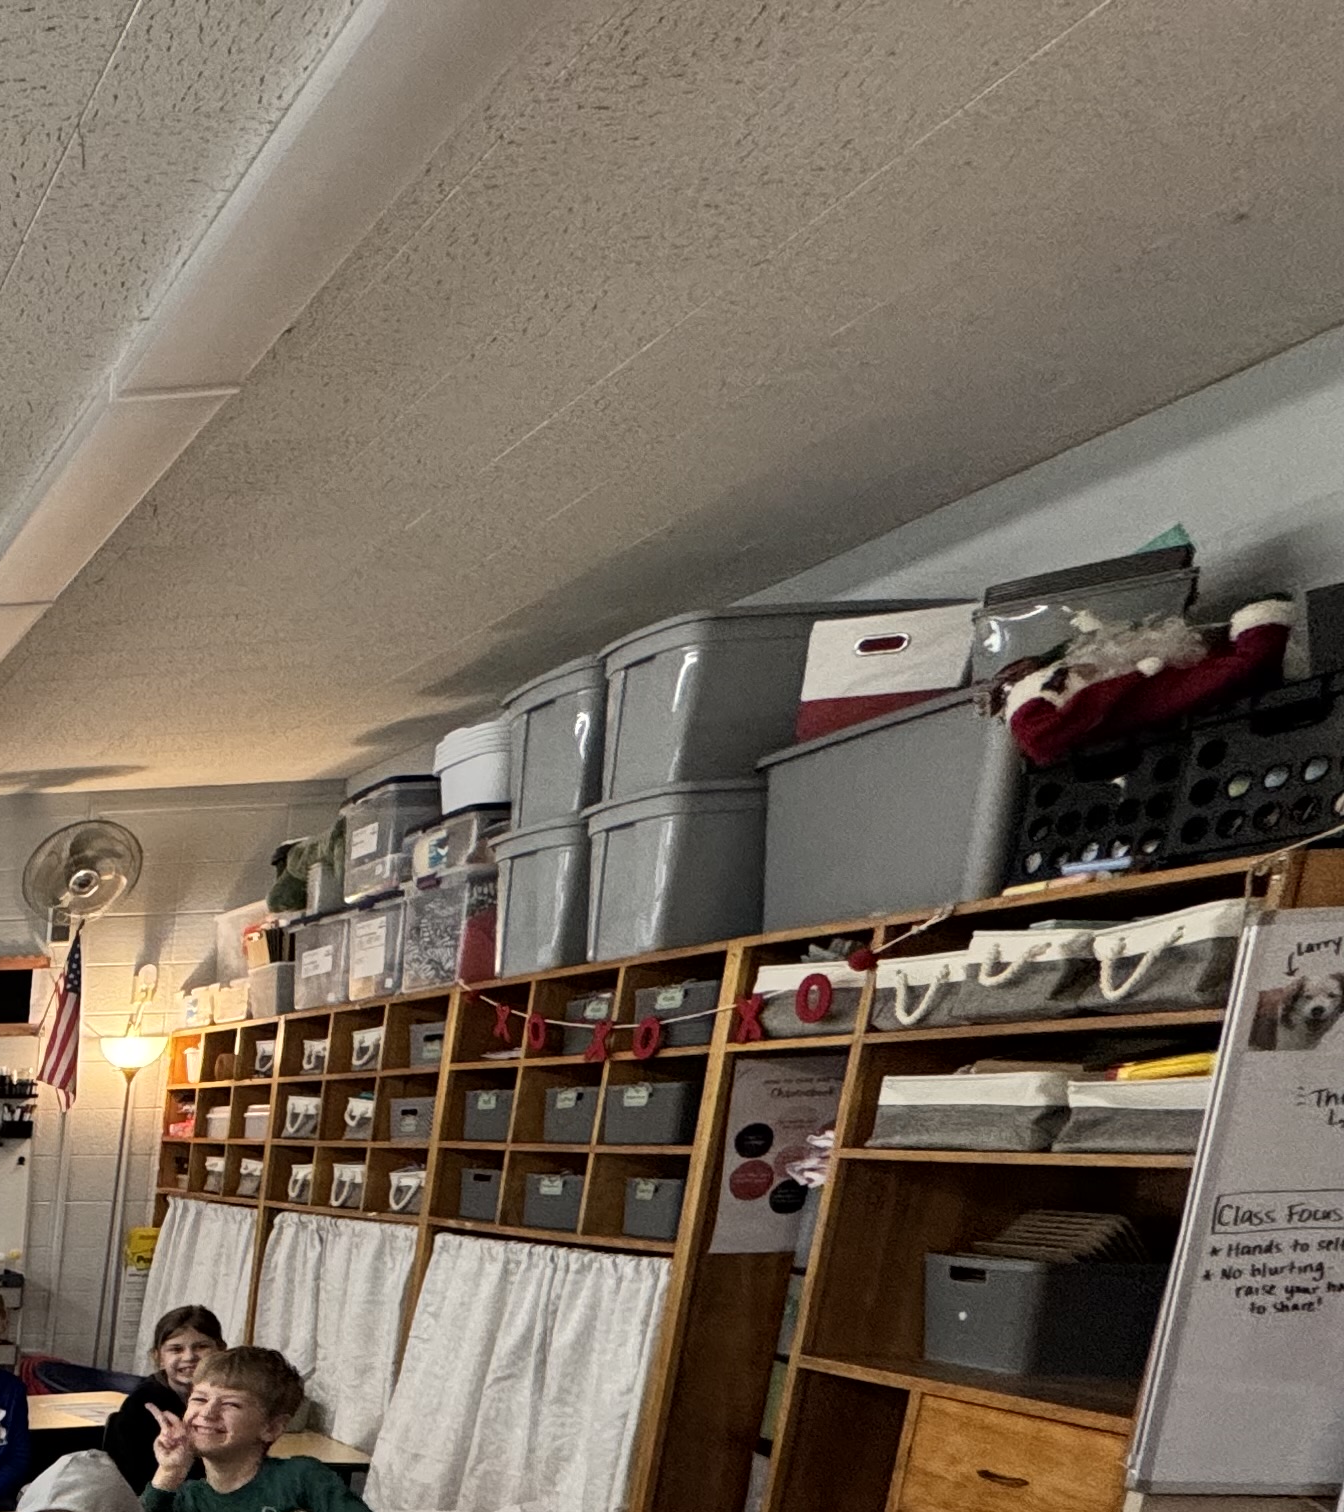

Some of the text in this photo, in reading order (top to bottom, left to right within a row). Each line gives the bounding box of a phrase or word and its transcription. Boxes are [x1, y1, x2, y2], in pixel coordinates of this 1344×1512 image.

[1217, 1203, 1344, 1227] Class Focus
[1226, 1240, 1282, 1258] Hands
[1292, 1239, 1310, 1252] to
[1221, 1267, 1243, 1281] No
[1235, 1284, 1276, 1298] raise
[1284, 1284, 1320, 1301] your
[1250, 1302, 1267, 1315] to
